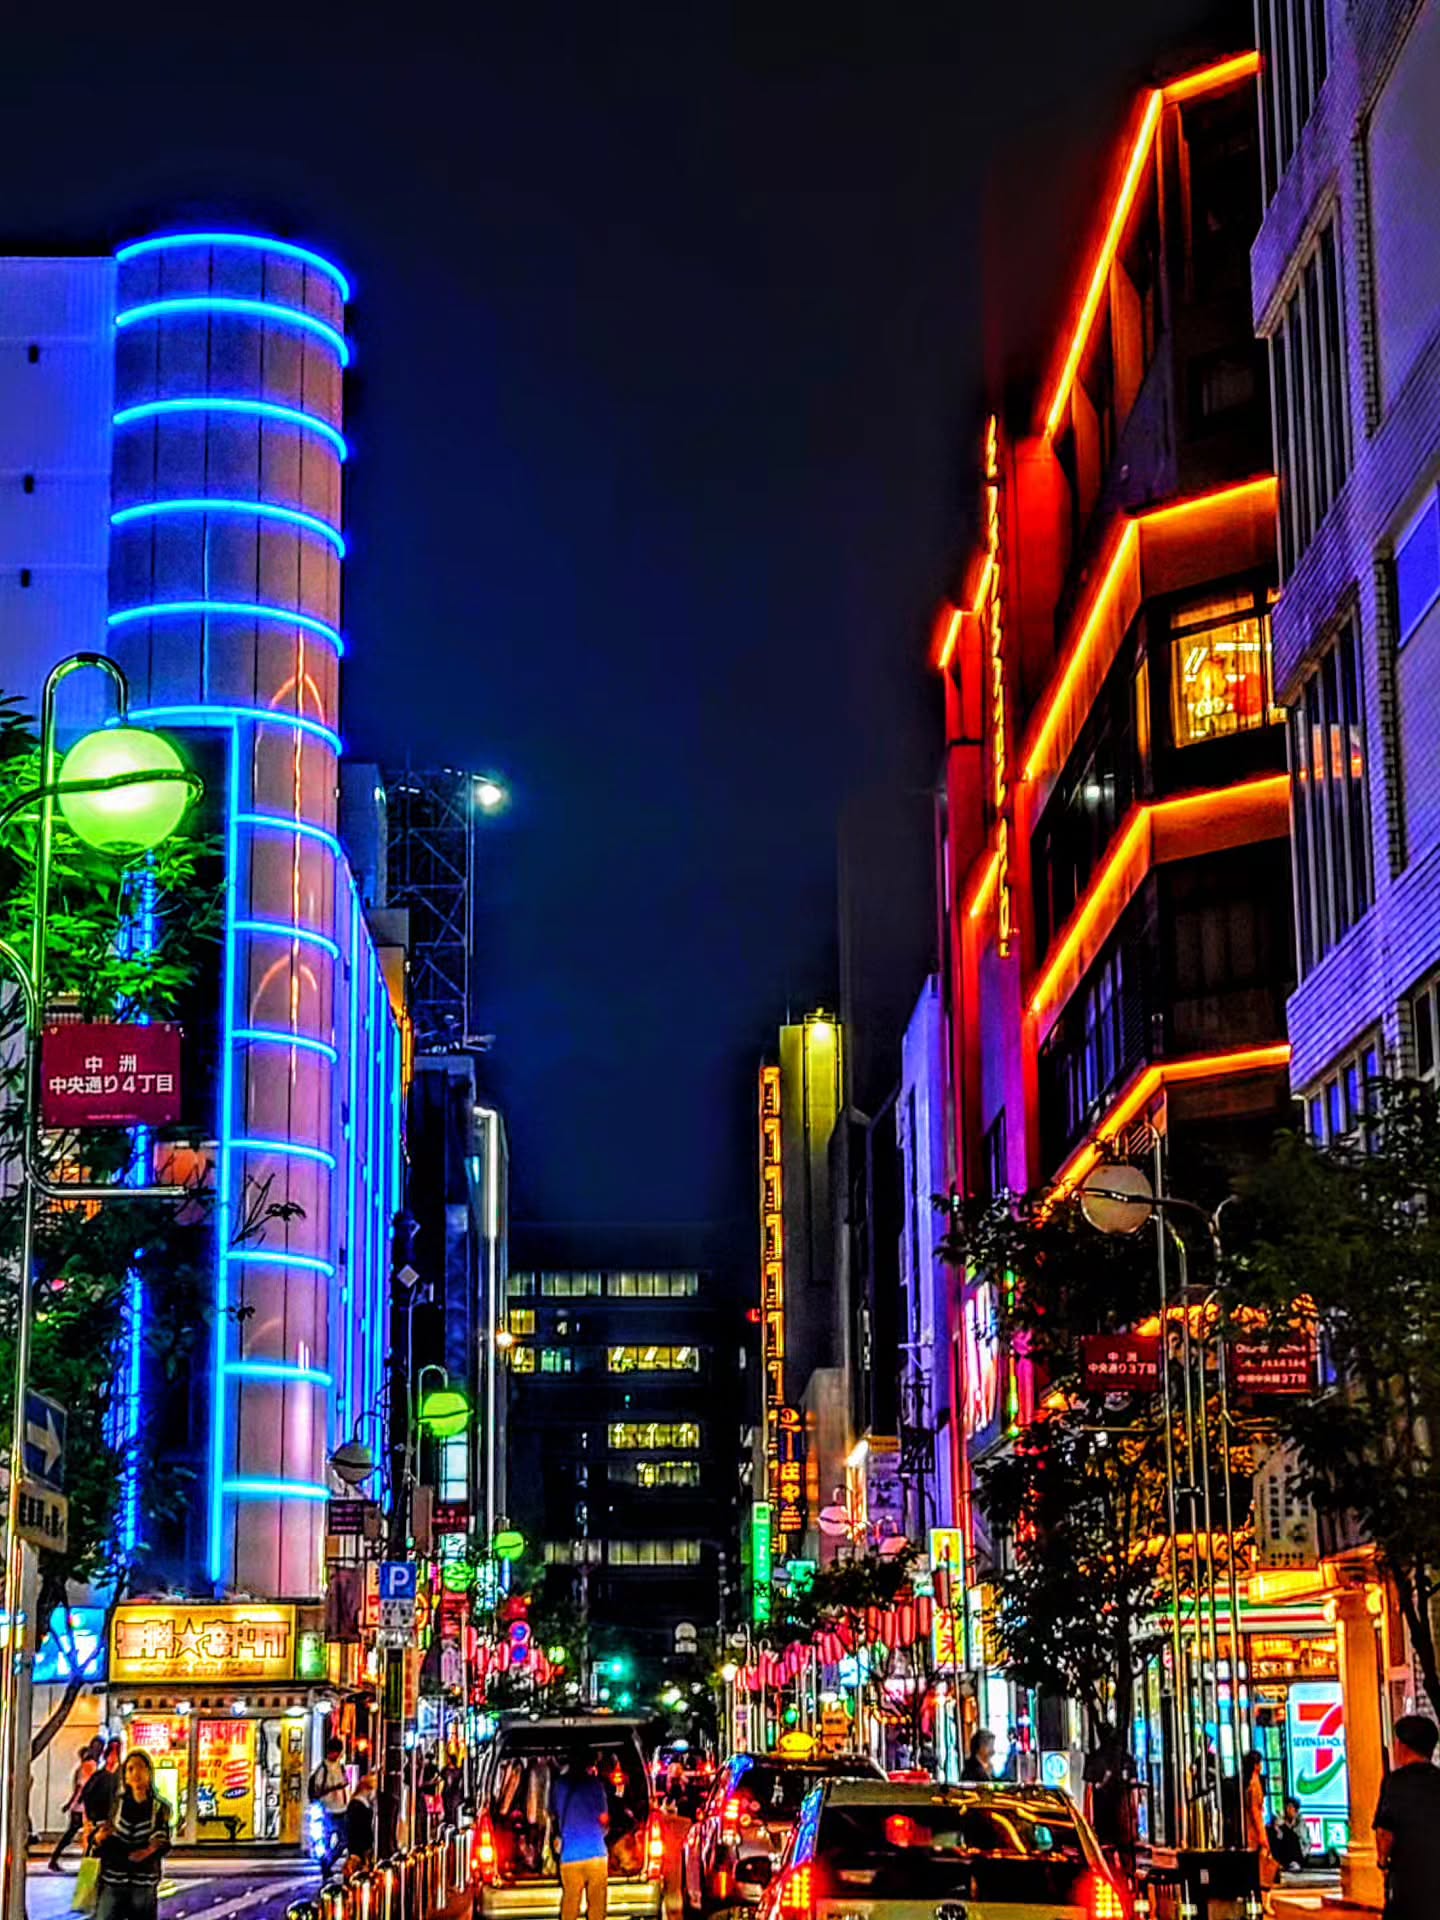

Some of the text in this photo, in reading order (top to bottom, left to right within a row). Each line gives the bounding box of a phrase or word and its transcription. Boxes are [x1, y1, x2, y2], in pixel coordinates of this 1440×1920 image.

[48, 1074, 173, 1095] 中央通り4丁目
[389, 1567, 410, 1595] P
